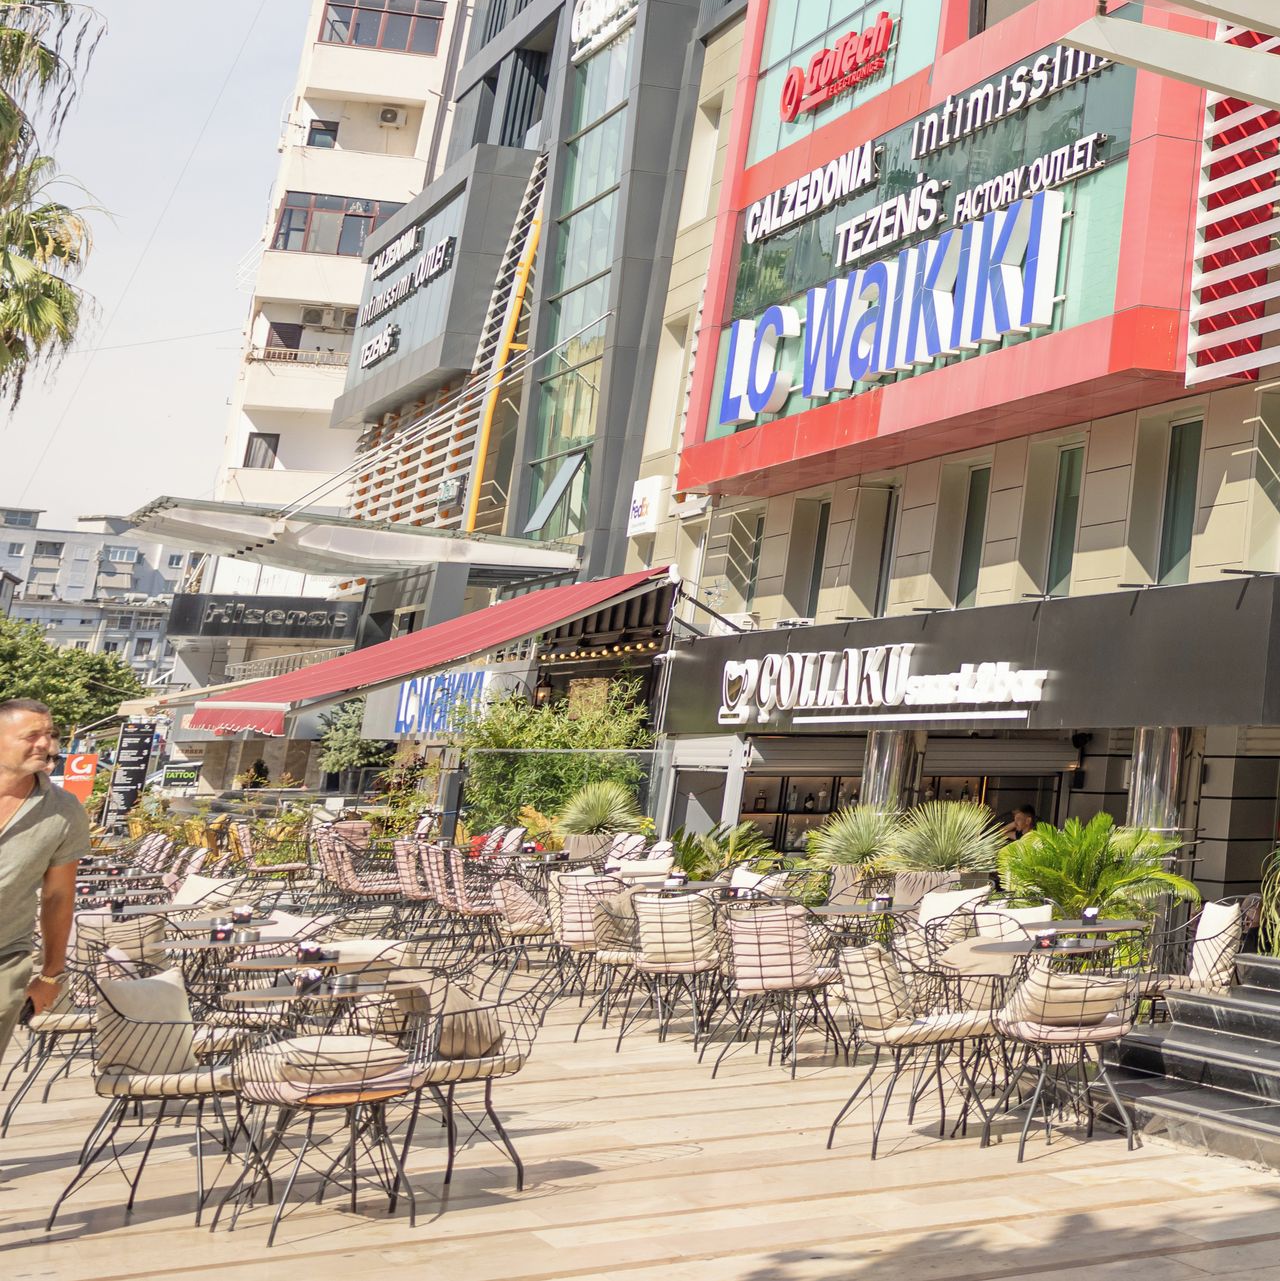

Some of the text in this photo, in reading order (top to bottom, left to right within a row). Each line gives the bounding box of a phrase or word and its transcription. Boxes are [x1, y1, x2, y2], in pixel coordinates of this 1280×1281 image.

[804, 11, 893, 95] GoTech
[827, 57, 886, 97] ELECTRONICS
[911, 44, 1109, 160] intimissim
[746, 140, 876, 244] CALZEDONIA
[835, 173, 940, 267] TEZENIS
[953, 132, 1104, 226] FACTORY OUTLET
[371, 225, 417, 281] CALZEDONIA
[414, 236, 452, 288] OUTLET
[719, 305, 801, 426] LC
[203, 601, 348, 627] Hisense
[166, 771, 196, 779] TATTOO
